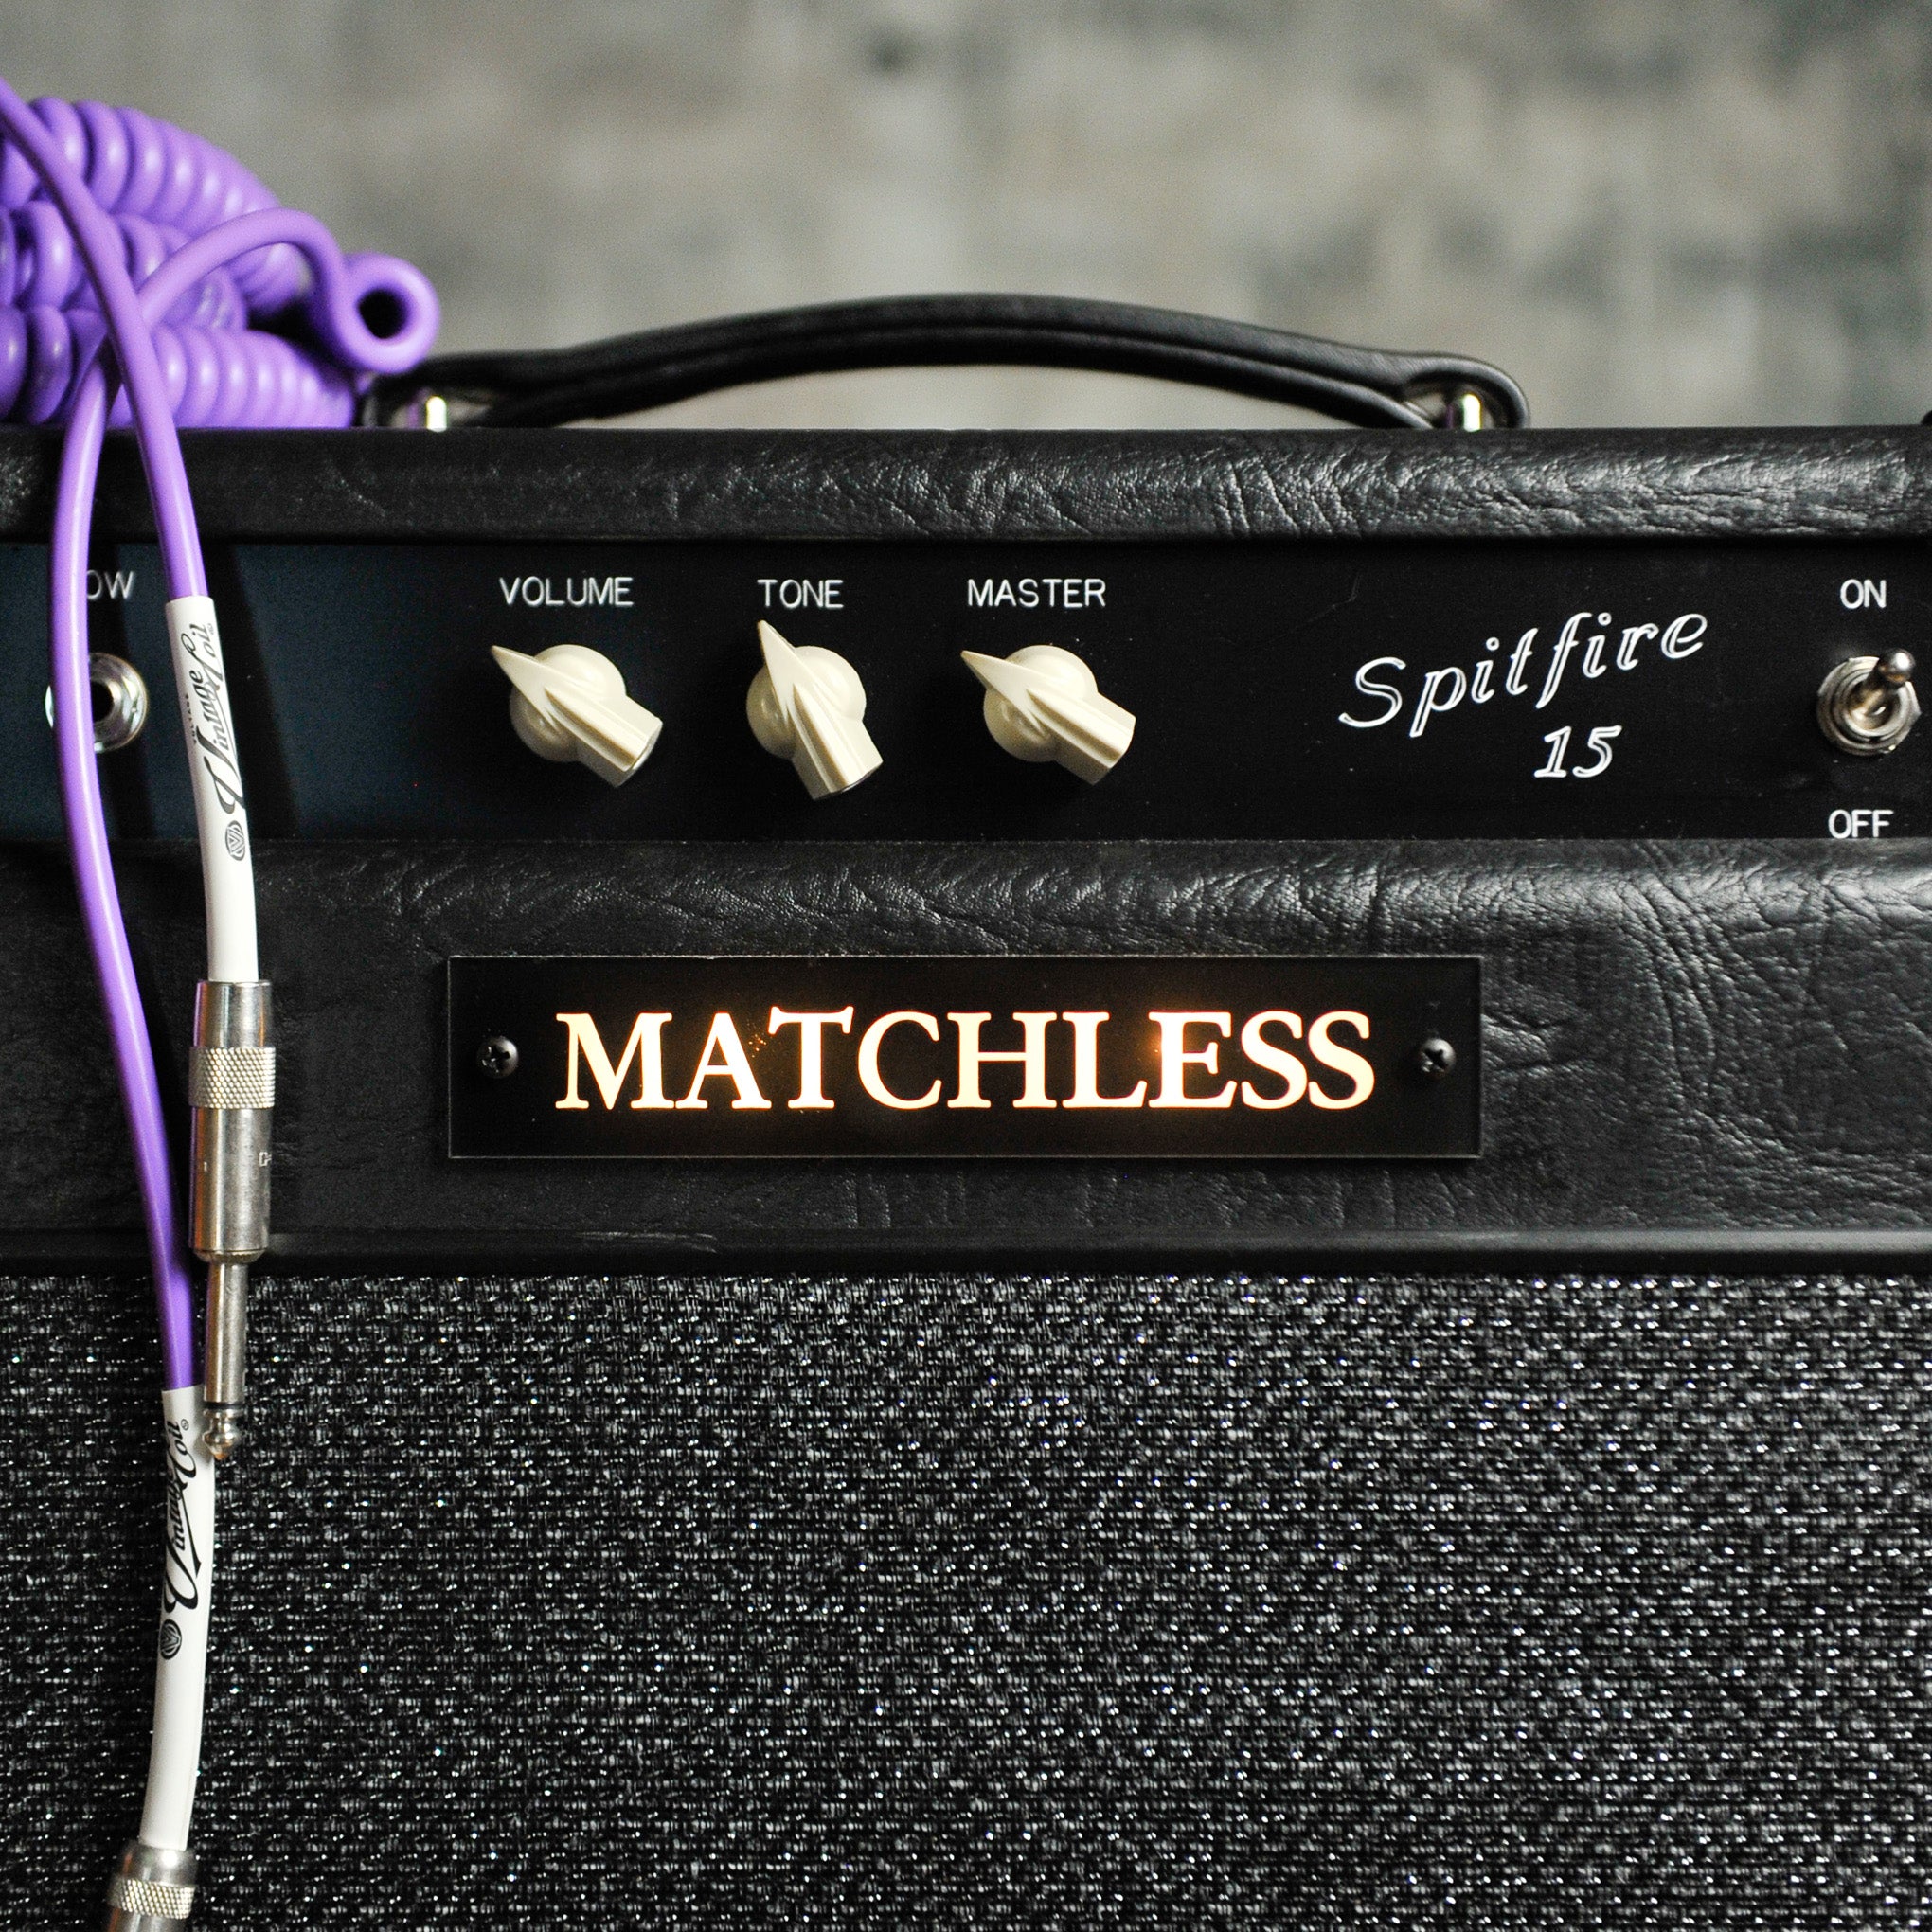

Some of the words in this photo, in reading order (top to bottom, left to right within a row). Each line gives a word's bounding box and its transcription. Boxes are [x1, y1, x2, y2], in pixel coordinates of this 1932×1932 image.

[87, 570, 135, 600] OW
[500, 576, 635, 607] VOLUME
[757, 579, 844, 609] TONE
[967, 578, 1106, 609] MASTER
[1840, 579, 1887, 609] ON
[181, 623, 224, 690] Coil
[1338, 612, 1708, 738] Spitfire
[189, 670, 246, 814] Vintage
[1534, 724, 1622, 778] 15
[1828, 810, 1894, 838] OFF
[556, 1007, 1375, 1110] MATCHLESS
